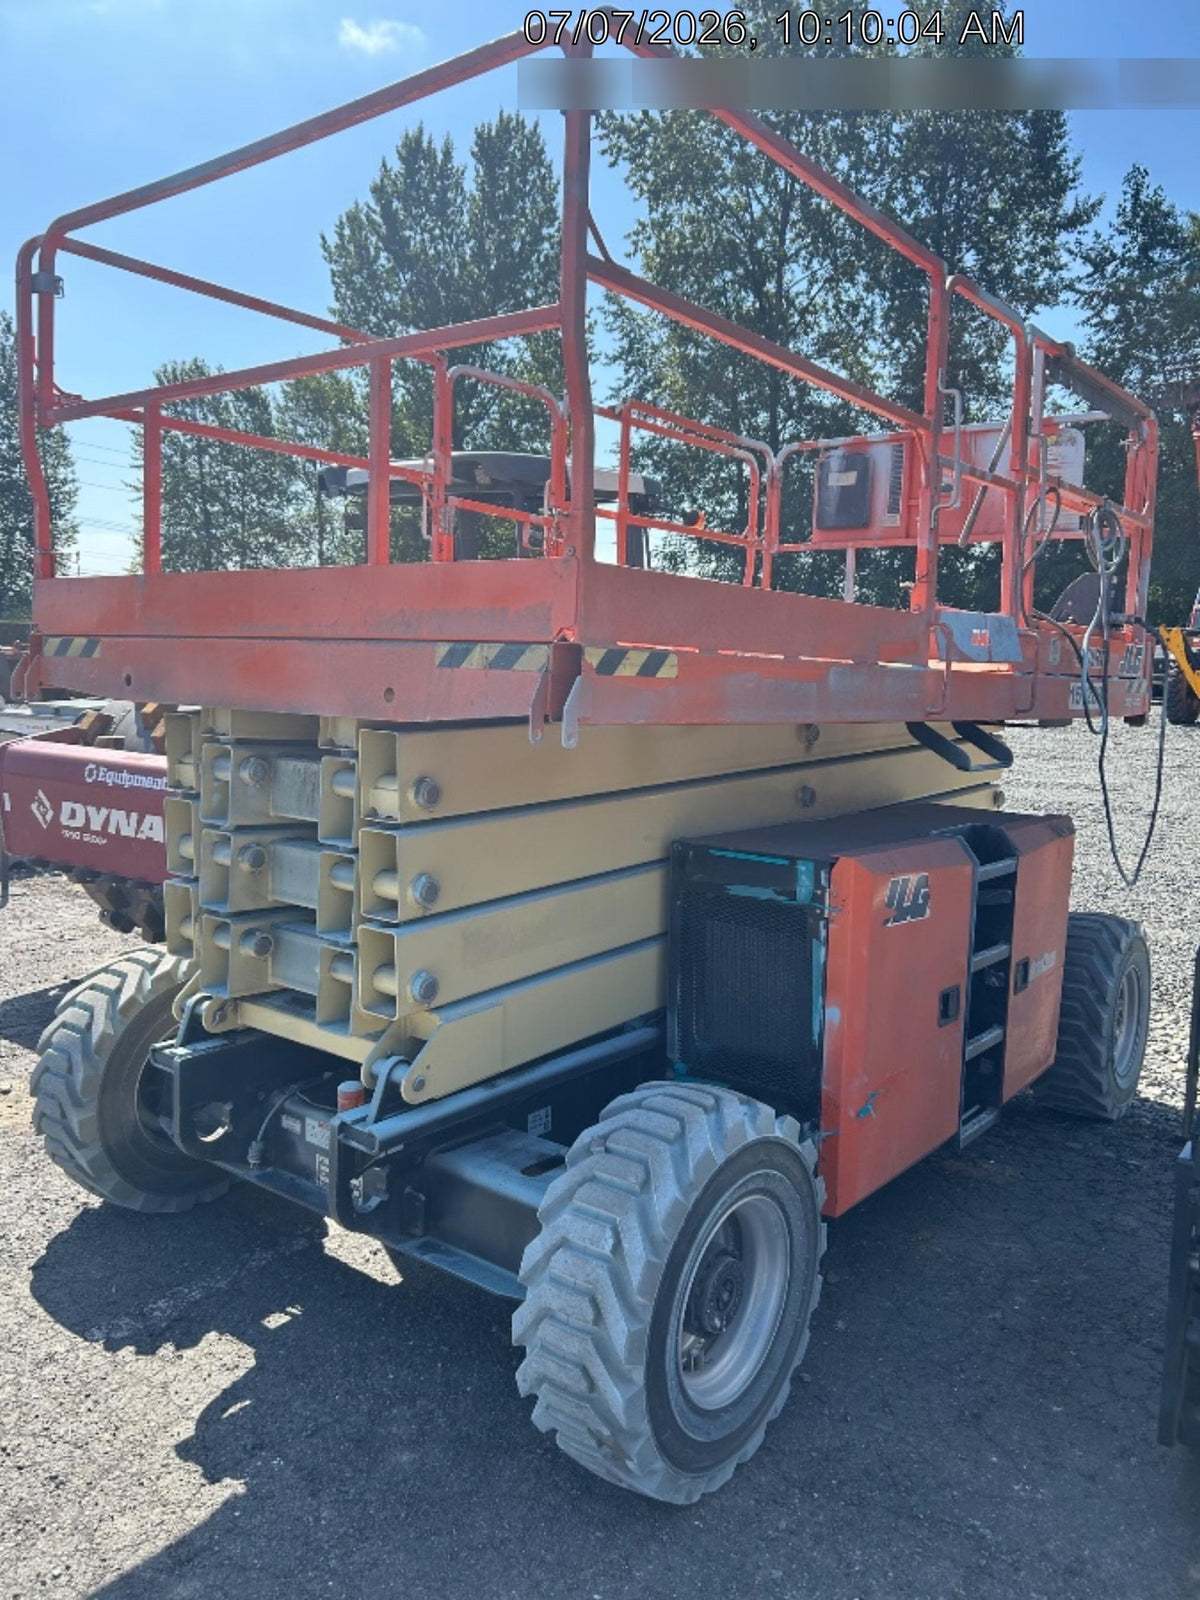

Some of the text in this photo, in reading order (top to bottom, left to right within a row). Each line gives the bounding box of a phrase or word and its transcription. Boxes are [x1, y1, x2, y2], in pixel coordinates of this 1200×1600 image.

[97, 767, 168, 791] Equipment
[60, 801, 165, 843] DYNA
[883, 873, 930, 927] JLG
